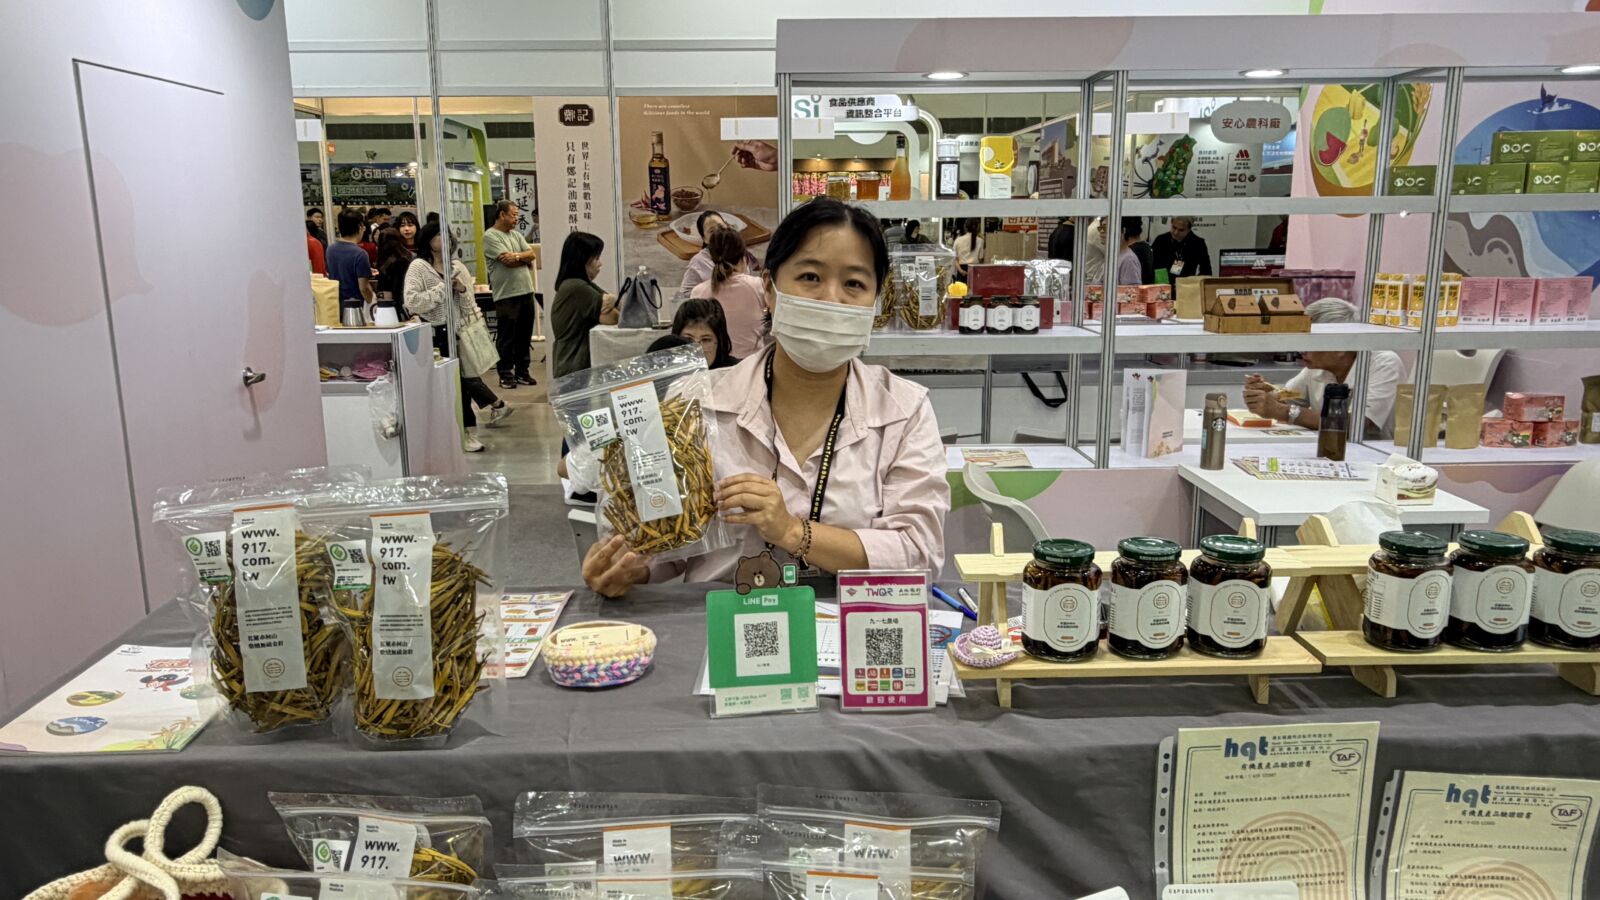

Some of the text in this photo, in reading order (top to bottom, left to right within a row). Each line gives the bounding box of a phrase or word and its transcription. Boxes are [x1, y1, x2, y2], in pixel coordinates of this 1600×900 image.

[829, 97, 876, 108] 食品供應商
[846, 108, 902, 119] 資訊整合平台
[620, 398, 647, 409] www.
[621, 407, 643, 418] 917.
[623, 416, 647, 426] com.
[626, 428, 638, 436] tw
[241, 529, 280, 539] www.
[381, 535, 417, 544] www.
[241, 542, 271, 554] 917.
[380, 547, 407, 559] 917.
[242, 556, 275, 567] com.
[382, 561, 410, 571] com.
[243, 571, 259, 581] tw
[383, 574, 397, 585] tw
[865, 587, 894, 597] TWQR
[743, 597, 760, 605] LINE
[866, 695, 907, 705] 歡迎使用
[1224, 735, 1269, 761] hqt
[1335, 752, 1356, 762] TAF
[1445, 783, 1492, 808] hqt
[1557, 808, 1578, 817] TAF
[365, 840, 400, 852] www.
[361, 854, 389, 870] 917.
[613, 852, 654, 865] www.
